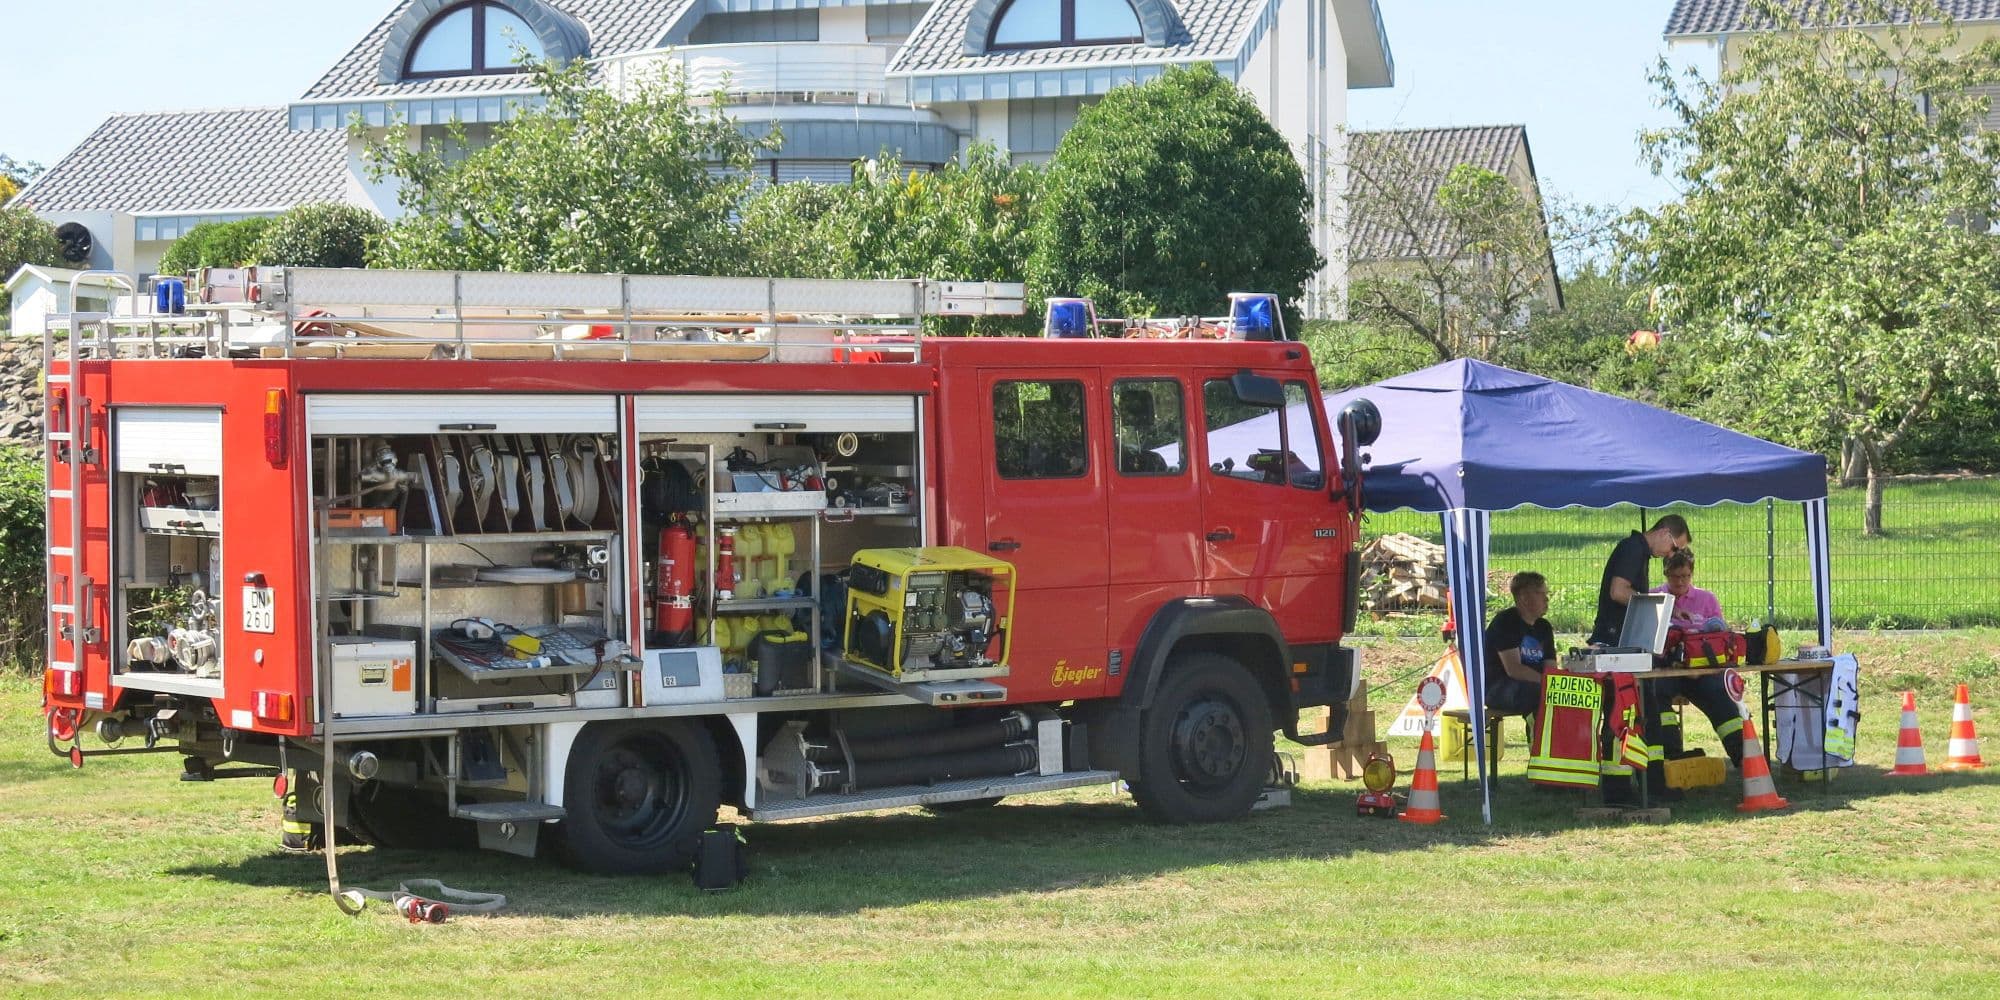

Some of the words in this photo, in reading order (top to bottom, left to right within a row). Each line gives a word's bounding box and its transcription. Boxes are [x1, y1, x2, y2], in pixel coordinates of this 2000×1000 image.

[251, 591, 266, 609] DN
[246, 611, 270, 629] 260
[1521, 646, 1543, 658] NASA
[1052, 658, 1102, 687] Ziegler
[1550, 677, 1599, 693] A-DIENST
[1547, 692, 1600, 709] HEIMBACH
